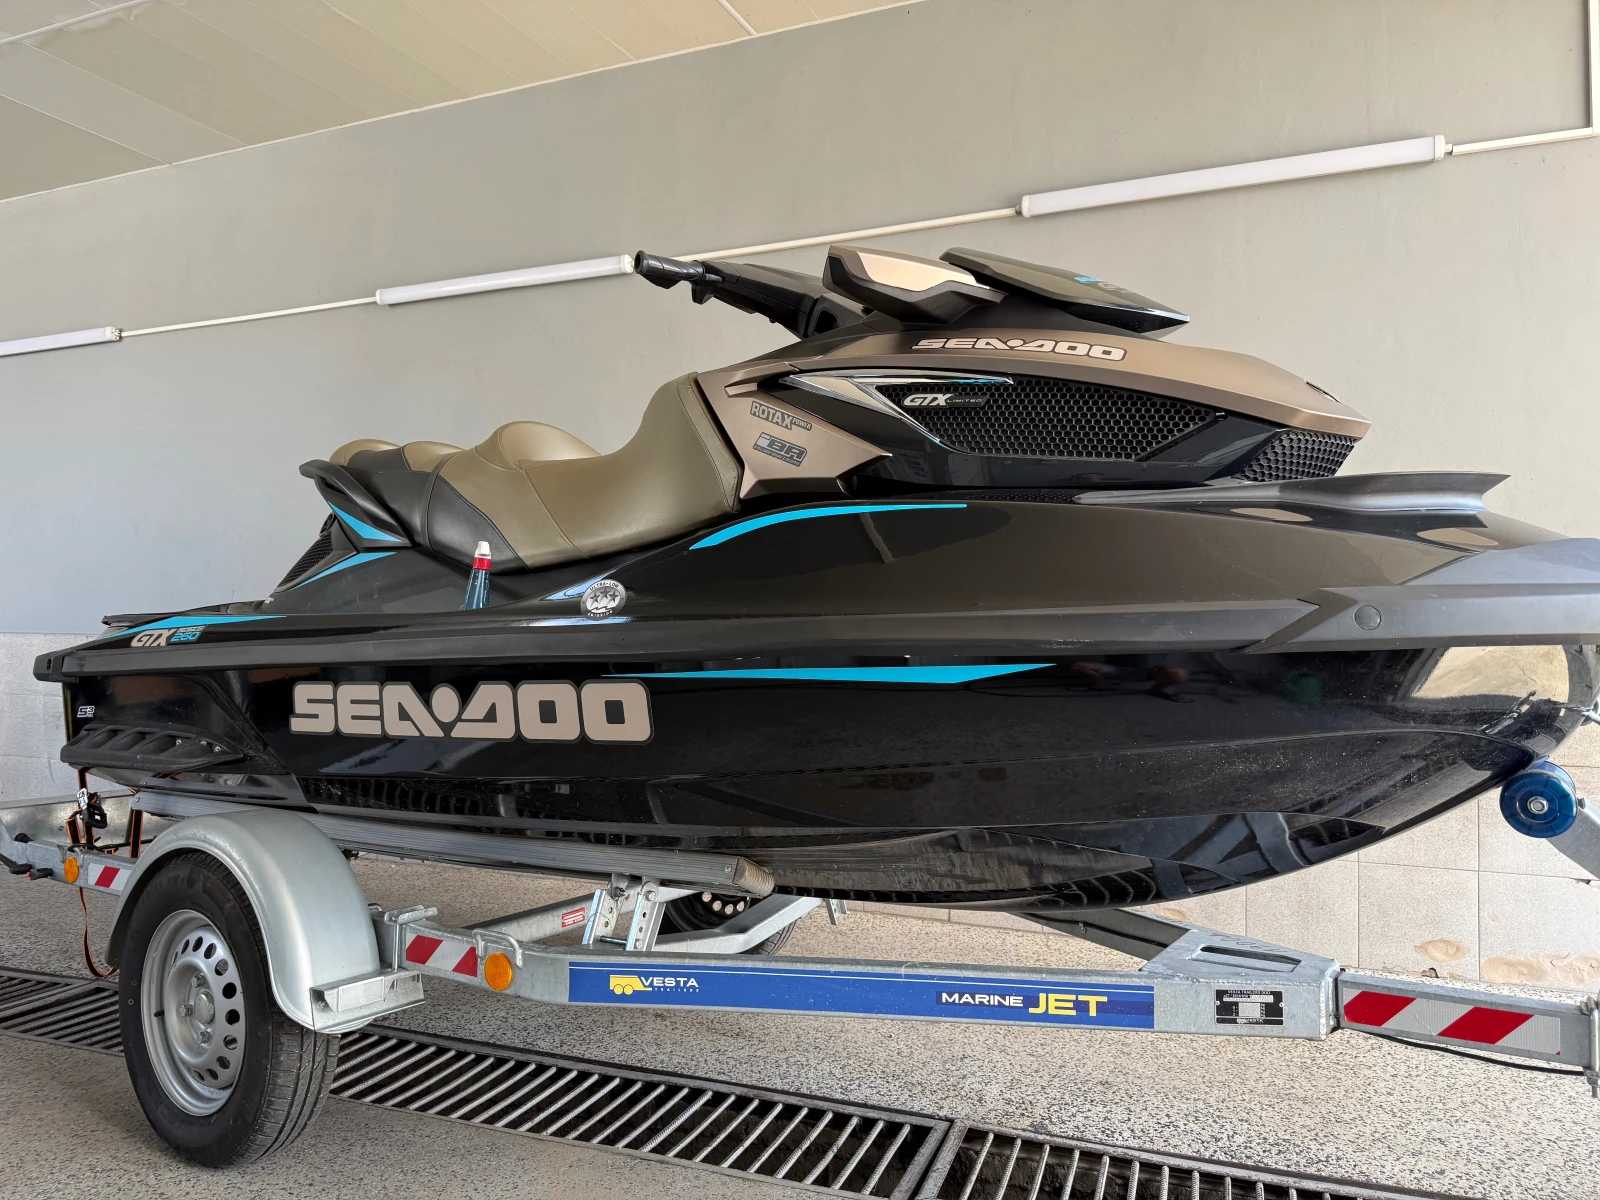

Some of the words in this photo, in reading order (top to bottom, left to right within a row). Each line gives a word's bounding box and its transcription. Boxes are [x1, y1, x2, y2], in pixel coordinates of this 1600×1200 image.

[903, 393, 955, 407] GTX
[751, 401, 793, 430] ROTAX
[792, 417, 812, 430] POWER
[130, 628, 178, 647] GTX
[170, 631, 201, 642] 260
[640, 976, 699, 987] VESTA
[941, 992, 1024, 1007] MARINE
[1028, 992, 1108, 1017] JET
